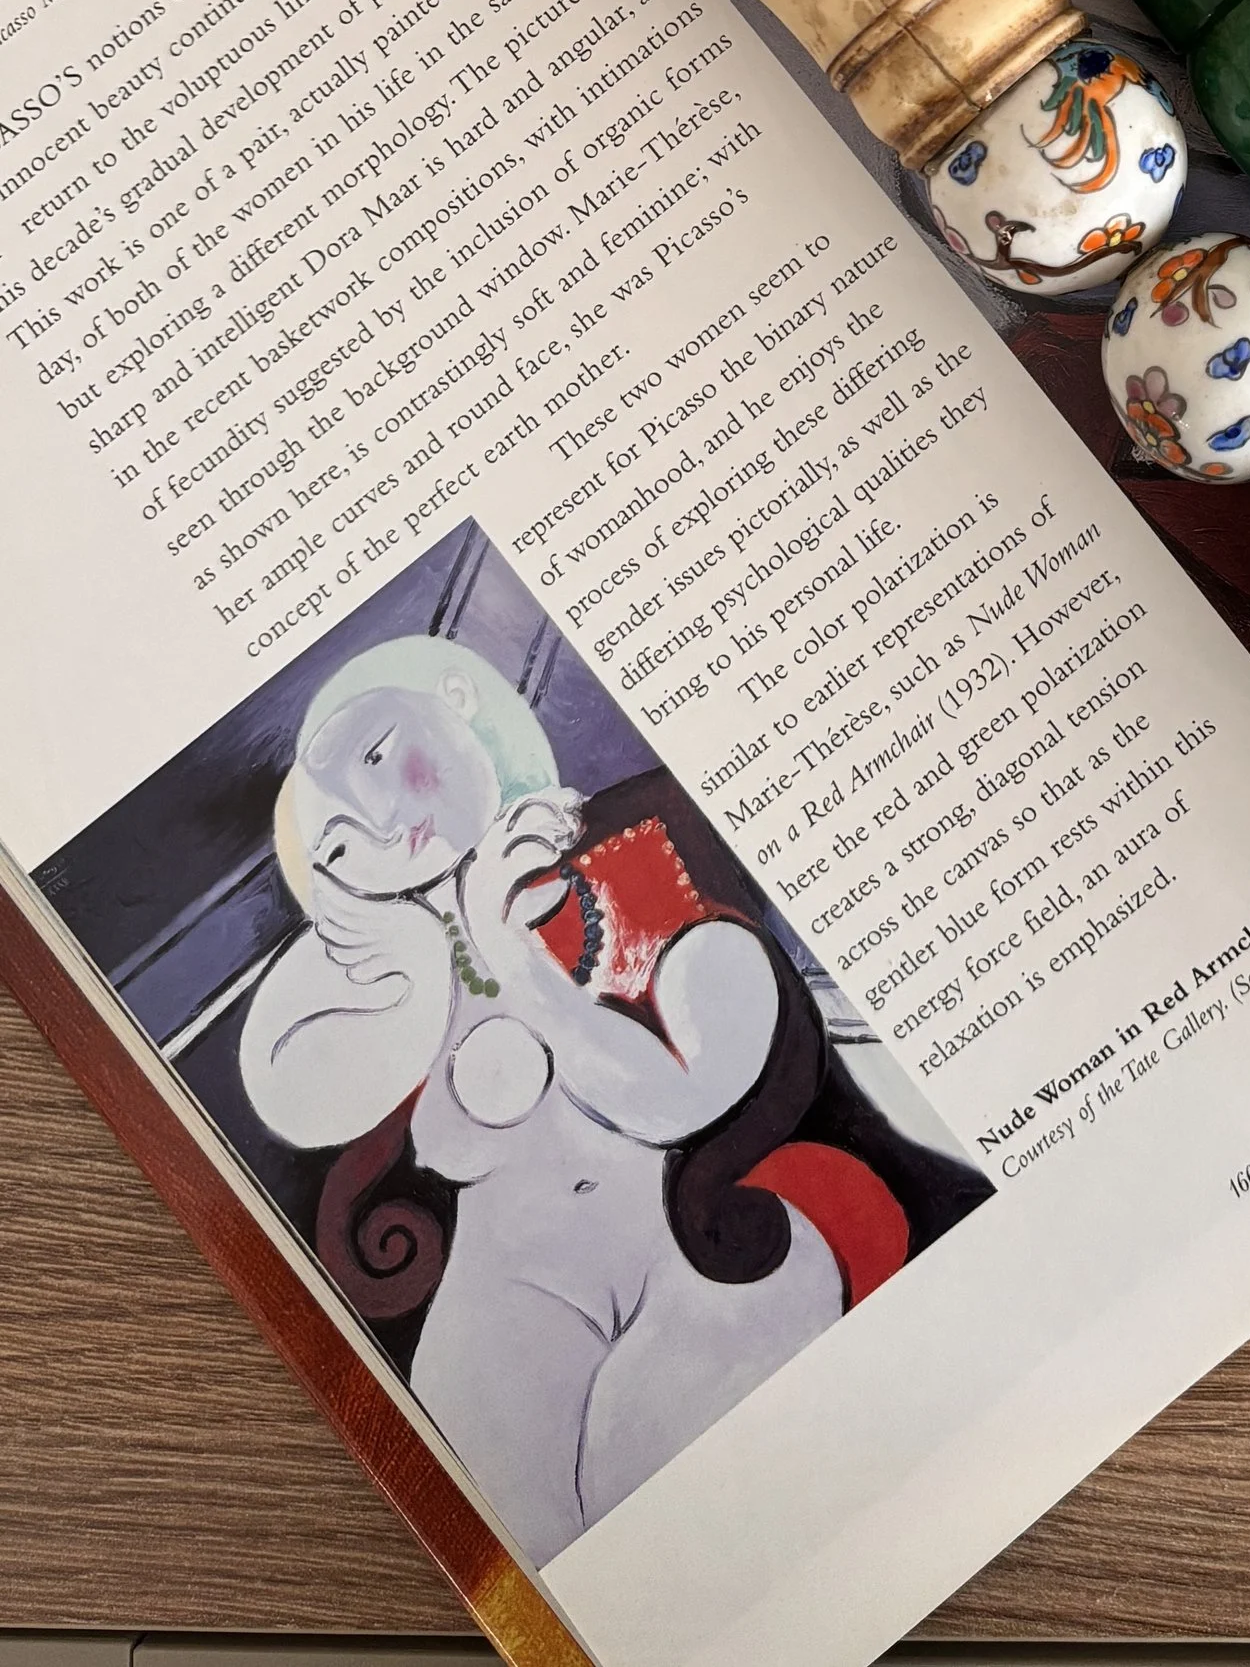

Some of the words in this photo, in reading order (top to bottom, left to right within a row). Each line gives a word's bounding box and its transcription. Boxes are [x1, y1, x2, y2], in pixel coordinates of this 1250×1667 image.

[0, 5, 37, 46] casso
[20, 175, 92, 236] return
[91, 152, 118, 175] to
[120, 118, 158, 151] the
[159, 17, 277, 116] voluptuous
[56, 383, 103, 420] but
[105, 296, 213, 385] exploring
[211, 283, 227, 299] a
[228, 203, 320, 283] different
[320, 93, 457, 208] morphology.
[448, 54, 501, 95] The
[88, 402, 148, 455] sharp
[151, 358, 194, 404] and
[191, 272, 305, 368] intelligent
[299, 226, 364, 277] Dora
[360, 173, 423, 228] Maar
[420, 156, 446, 178] is
[442, 105, 500, 159] hard
[502, 68, 545, 115] and
[547, 5, 636, 77] angular,
[110, 464, 142, 489] in
[142, 430, 181, 464] the
[182, 370, 253, 433] recent
[247, 270, 376, 374] basketwork
[378, 153, 526, 272] compositions,
[522, 103, 579, 149] with
[575, 1, 704, 107] intimations
[166, 512, 218, 557] seen
[218, 438, 307, 513] through
[307, 406, 346, 440] the
[341, 293, 476, 408] background
[475, 223, 571, 299] window.
[566, 89, 742, 226] Marie-Thérèse,
[547, 407, 618, 462] These
[619, 371, 663, 409] two
[663, 303, 748, 370] women
[748, 257, 806, 307] seem
[804, 235, 831, 258] to
[246, 583, 333, 656] concept
[335, 550, 362, 585] of
[362, 528, 401, 562] the
[402, 462, 481, 538] perfect
[483, 413, 542, 464] earth
[543, 344, 631, 417] mother.
[511, 472, 607, 555] represent
[605, 442, 642, 477] for
[637, 383, 718, 448] Picasso
[719, 350, 758, 384] the
[752, 291, 828, 352] binary
[829, 235, 898, 296] nature
[565, 557, 641, 630] process
[644, 524, 670, 559] of
[671, 449, 776, 537] exploring
[772, 404, 829, 453] these
[831, 327, 926, 406] differing
[619, 613, 714, 691] differing
[710, 493, 852, 626] psychological
[853, 428, 939, 506] qualities
[939, 386, 988, 430] they
[639, 673, 710, 727] bring
[706, 653, 732, 677] to
[728, 623, 768, 656] his
[768, 543, 860, 635] personal
[853, 517, 902, 555] life.
[700, 733, 772, 797] similar
[772, 713, 799, 737] to
[803, 653, 870, 713] earlier
[871, 526, 1028, 659] representations
[1030, 493, 1057, 528] of
[736, 663, 789, 704] The
[793, 613, 849, 665] color
[850, 512, 978, 625] polarization
[974, 492, 999, 515] is
[757, 838, 782, 866] on
[787, 823, 801, 843] a
[799, 779, 846, 829] Red
[851, 712, 935, 795] Armchair
[937, 652, 1017, 720] (1932).
[1010, 569, 1122, 656] However,
[775, 857, 831, 902] here
[832, 825, 870, 859] the
[871, 786, 912, 829] red
[912, 750, 956, 797] and
[957, 706, 1021, 767] green
[1020, 602, 1149, 717] polarization
[810, 873, 882, 935] creates
[883, 861, 900, 877] a
[900, 802, 977, 864] strong,
[975, 718, 1067, 803] diagonal
[1066, 661, 1148, 728] tension
[864, 940, 939, 1012] gentler
[934, 901, 990, 945] blue
[989, 855, 1050, 905] form
[1049, 814, 1099, 859] rests
[1098, 755, 1175, 815] within
[1174, 719, 1217, 757] this
[918, 989, 1025, 1078] relaxation
[1020, 970, 1046, 993] is
[1049, 864, 1177, 973] emphasized.
[975, 1105, 1037, 1156] Nude
[1032, 1043, 1117, 1105] Woman
[1114, 1023, 1144, 1047] in
[1140, 979, 1190, 1026] Red
[1001, 1117, 1076, 1179] Courtesy
[1078, 1092, 1096, 1124] of
[1096, 1078, 1125, 1106] the
[1120, 1049, 1161, 1083] Tate
[1162, 998, 1229, 1051] Gallery.
